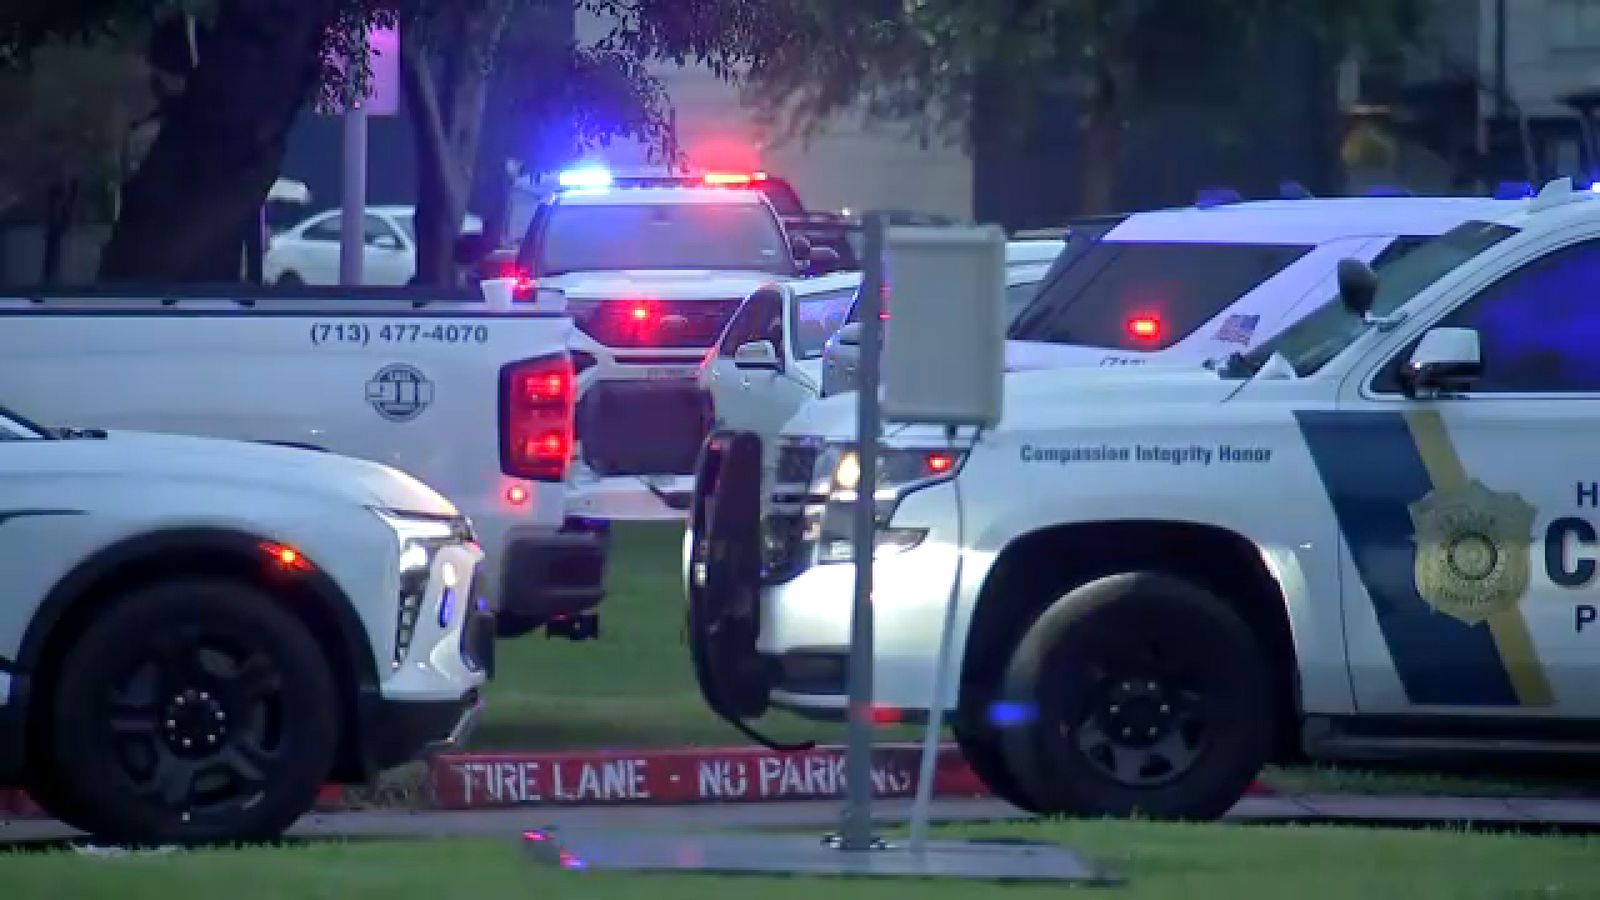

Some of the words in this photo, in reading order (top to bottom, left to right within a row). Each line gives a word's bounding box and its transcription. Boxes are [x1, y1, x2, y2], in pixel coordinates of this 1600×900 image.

[310, 322, 370, 346] (713)
[380, 324, 488, 343] 477-4070
[1019, 444, 1130, 465] Compassion
[1135, 443, 1213, 465] Integrity
[1219, 444, 1272, 463] Honor
[1576, 481, 1598, 507] H
[1544, 516, 1597, 588] C
[1575, 604, 1597, 632] P
[460, 760, 541, 803] FIRE
[552, 759, 650, 800] LANE
[759, 754, 911, 796] PARKNG
